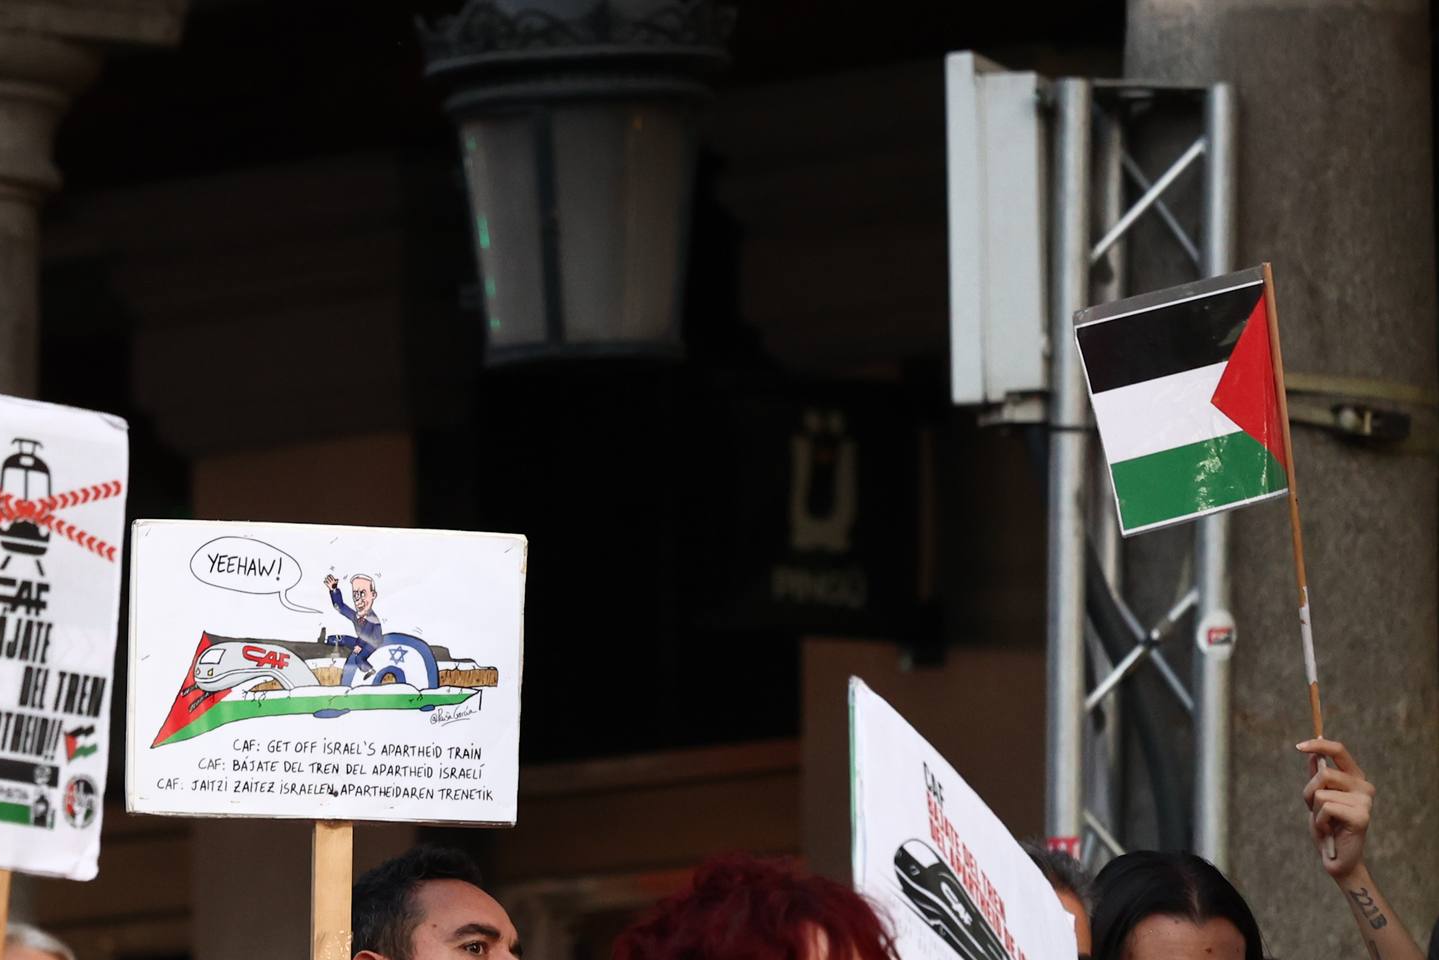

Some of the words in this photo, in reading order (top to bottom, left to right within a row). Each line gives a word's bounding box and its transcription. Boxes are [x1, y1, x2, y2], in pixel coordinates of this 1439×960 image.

[207, 552, 282, 582] YEEHAW!
[242, 645, 290, 669] CAF
[19, 665, 49, 710] DEL
[54, 670, 106, 718] TREN
[233, 738, 260, 753] CAF:
[267, 739, 291, 753] GET
[294, 740, 318, 754] OFF
[197, 757, 226, 771] CAF:
[232, 756, 280, 773] BÁJATE
[283, 760, 305, 773] DEL
[308, 761, 340, 775] TREN
[346, 763, 367, 776] DEL
